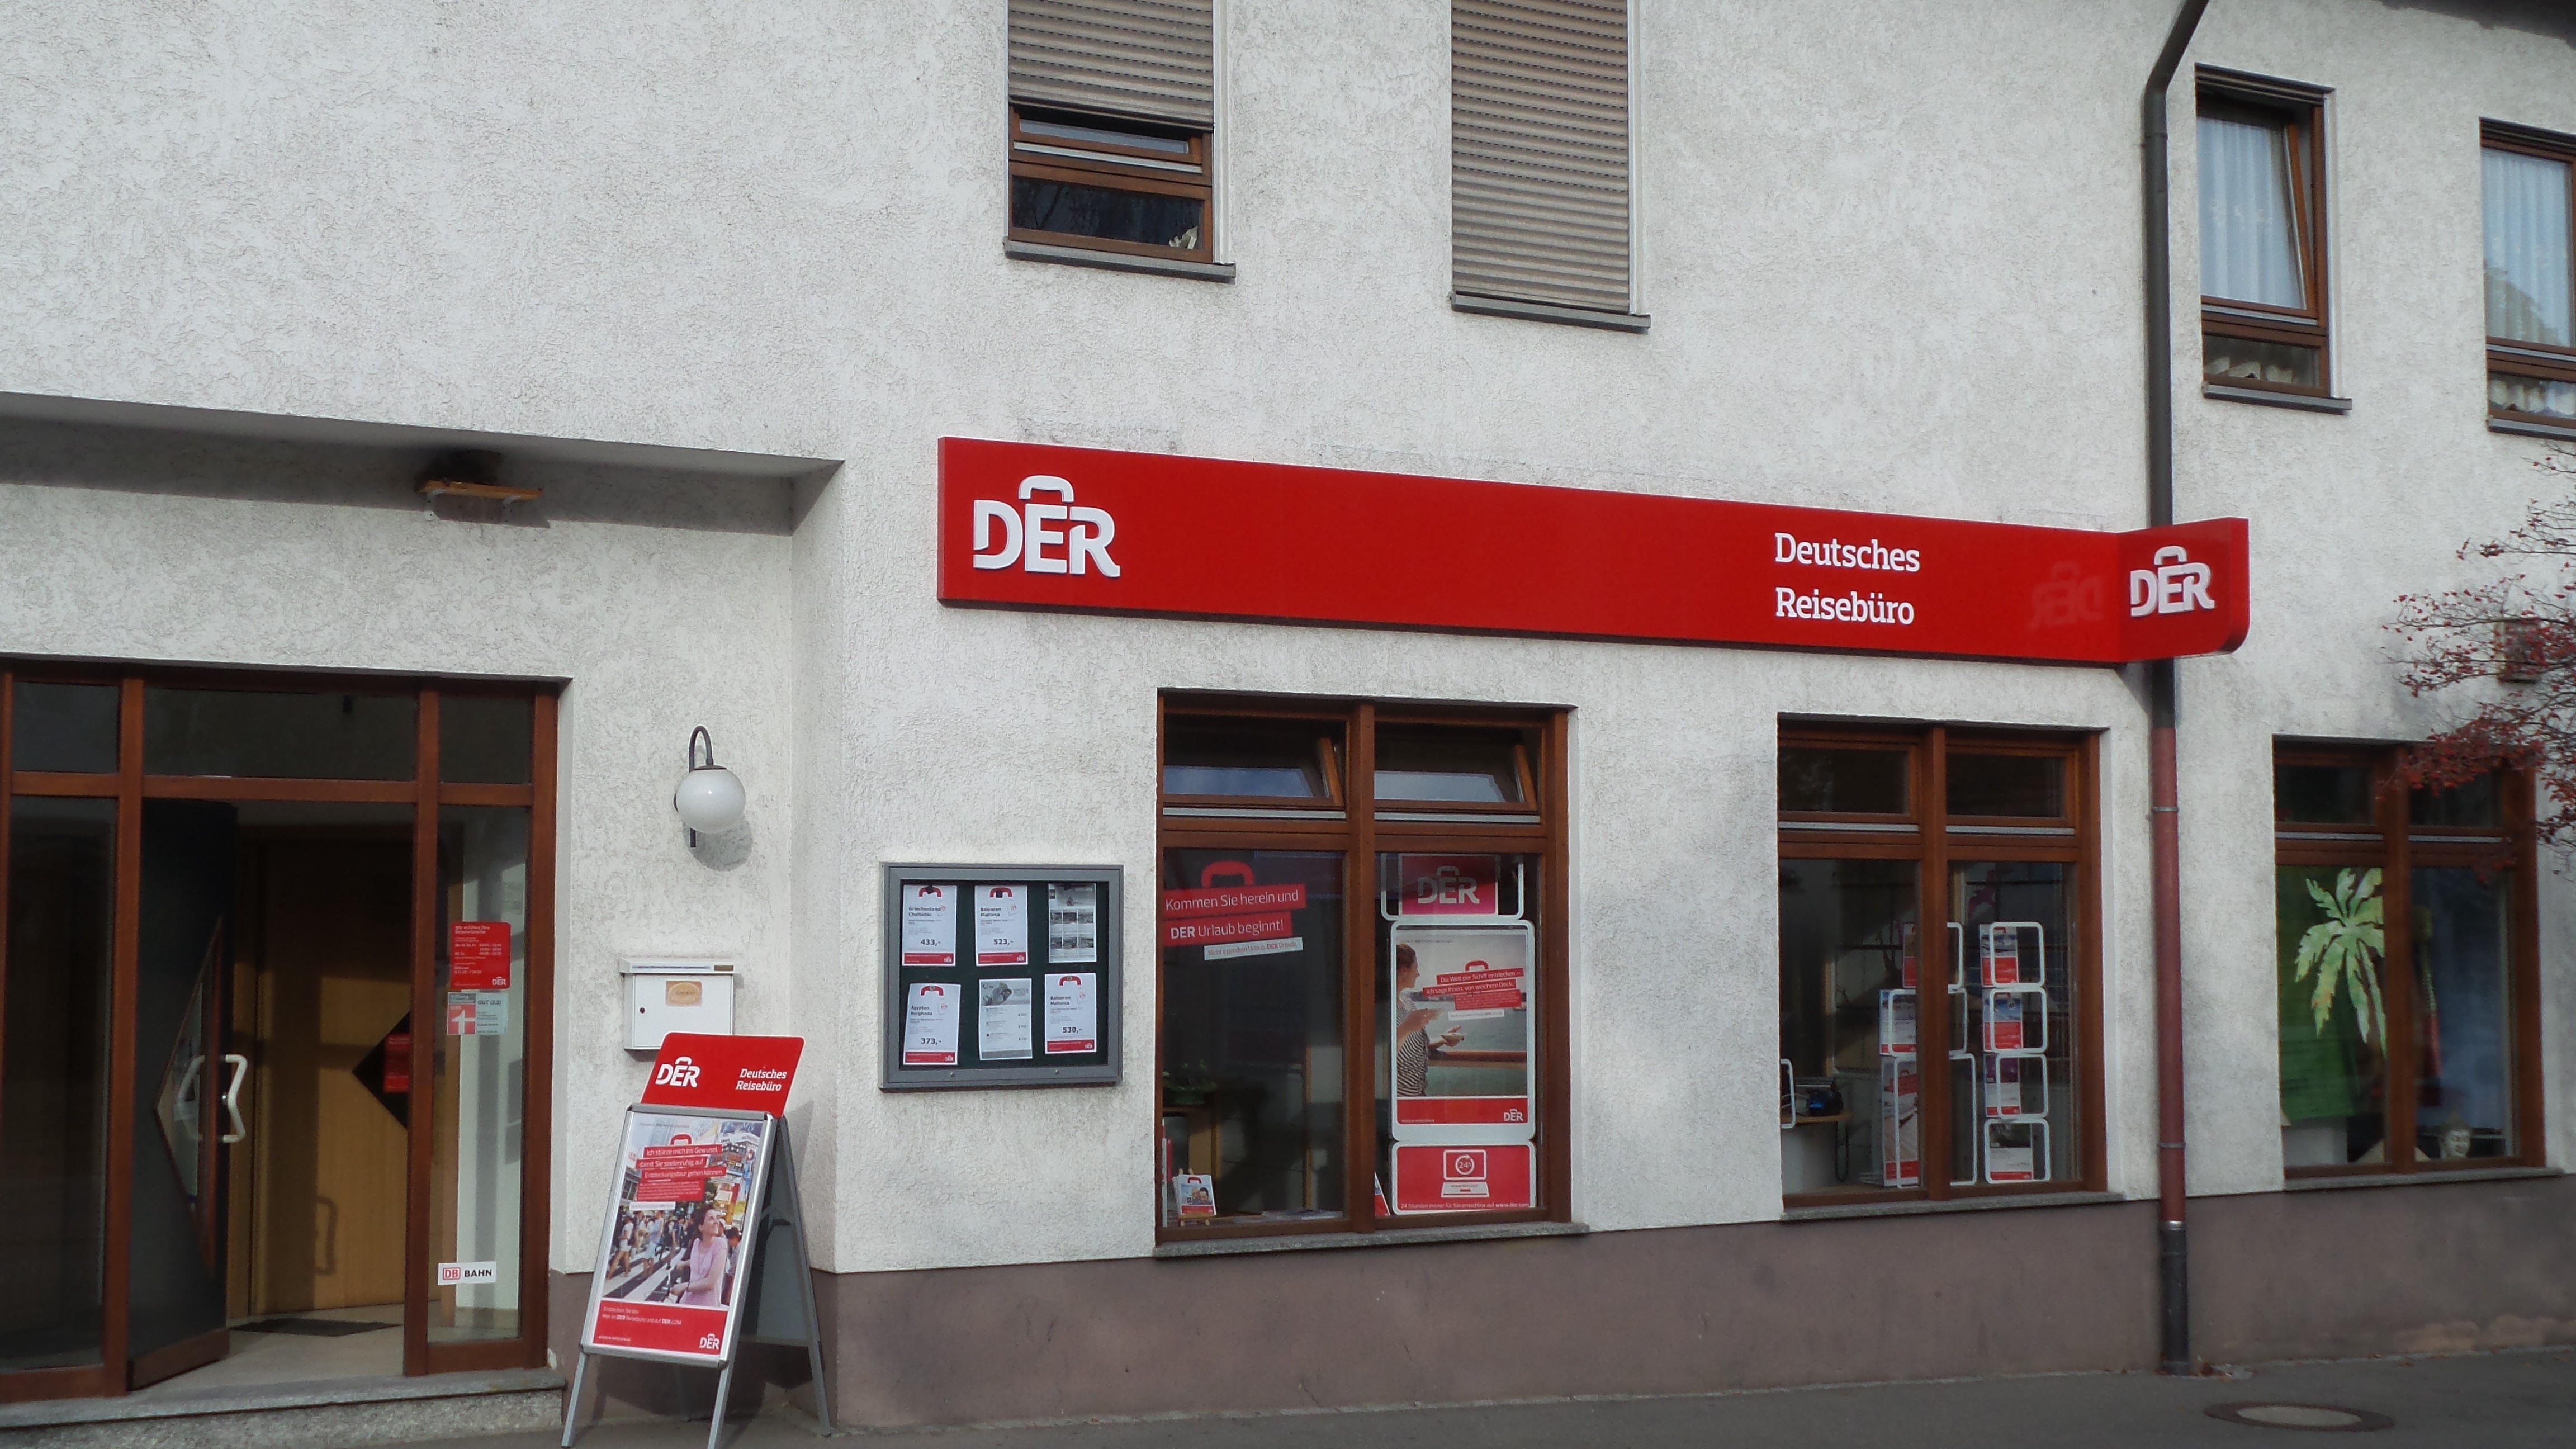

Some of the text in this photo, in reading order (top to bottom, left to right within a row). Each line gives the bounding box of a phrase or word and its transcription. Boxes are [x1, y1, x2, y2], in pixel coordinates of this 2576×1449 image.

[973, 475, 1120, 577] DER
[1775, 533, 1920, 571] Deutsches
[2130, 546, 2215, 617] DER
[1775, 587, 1915, 624] Reisebüro
[1418, 866, 1480, 903] DER
[1166, 889, 1298, 911] Kommen Sie herein und
[1171, 919, 1284, 939] DER Urlaub beginnt!
[492, 977, 506, 986] DER
[655, 1057, 700, 1087] DER
[739, 1068, 787, 1079] Deutsches
[735, 1080, 782, 1091] Reisebüro
[1504, 1109, 1523, 1121] DER
[444, 1269, 492, 1278] DB BAHN
[699, 1333, 720, 1350] DER
